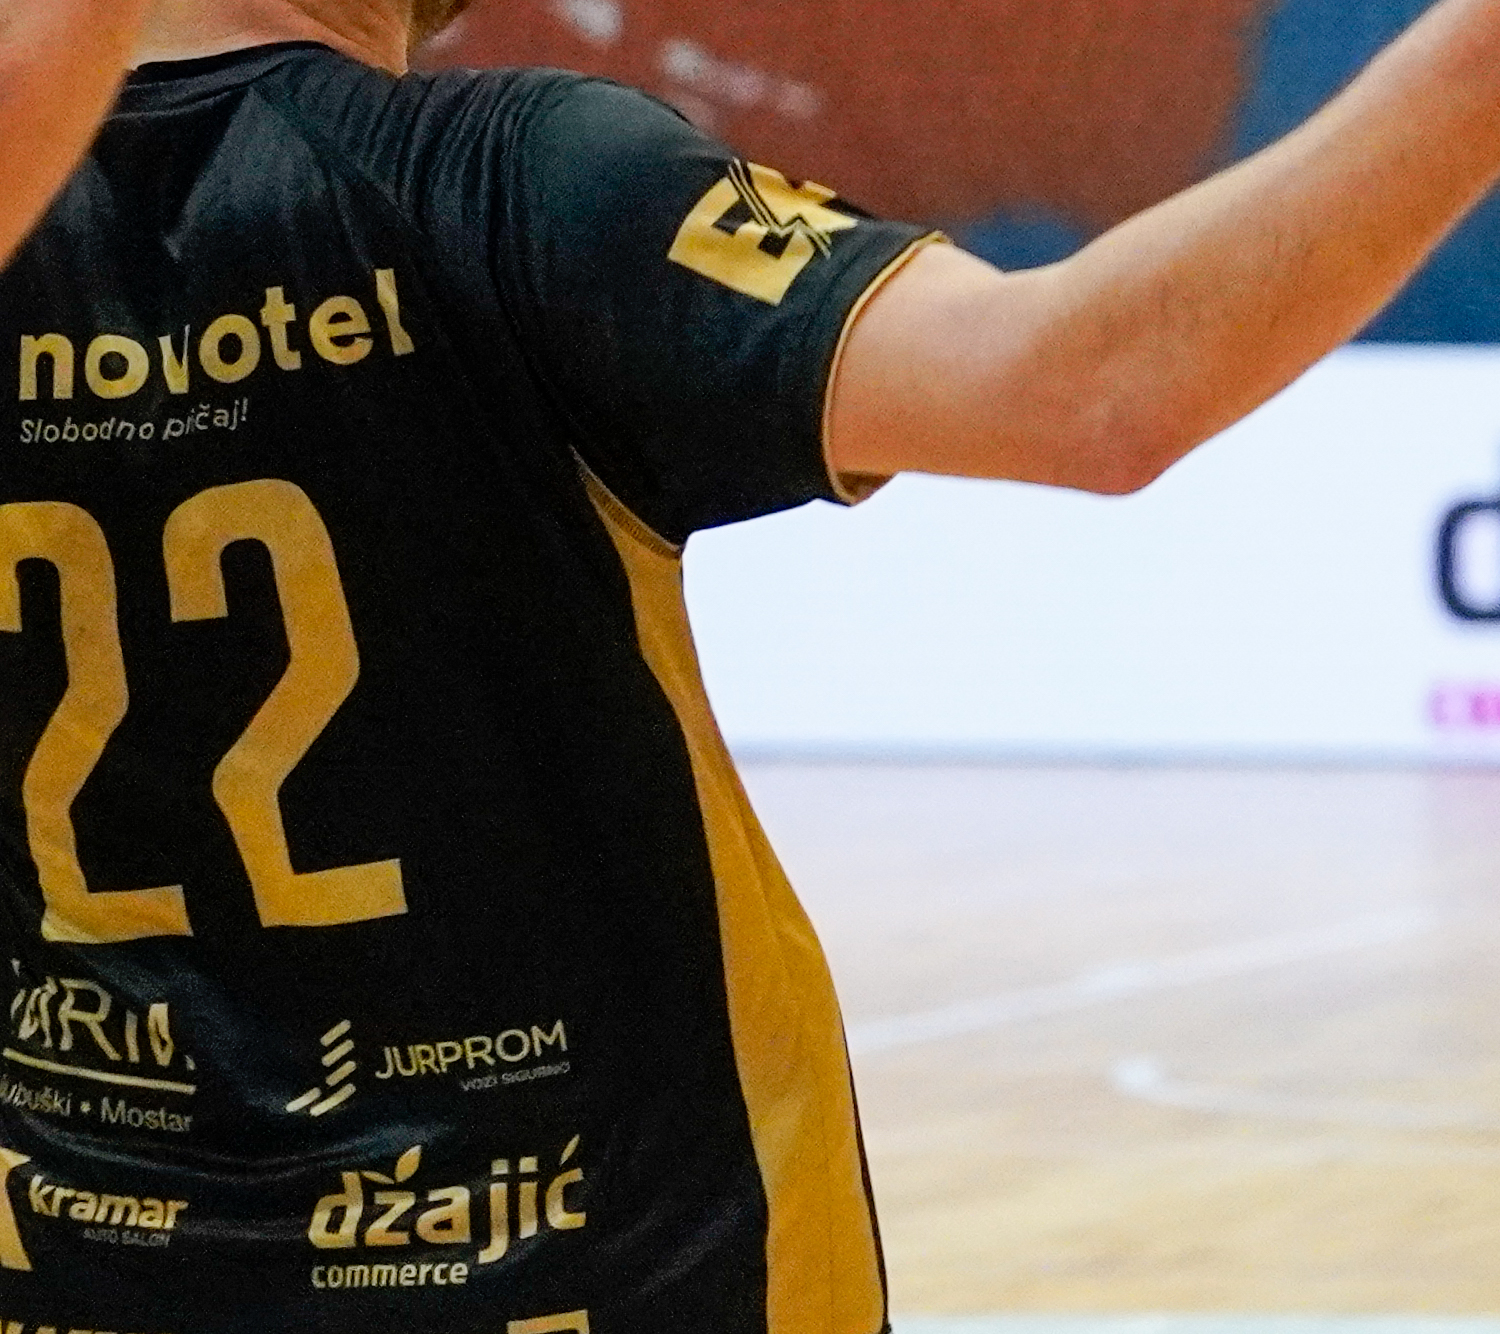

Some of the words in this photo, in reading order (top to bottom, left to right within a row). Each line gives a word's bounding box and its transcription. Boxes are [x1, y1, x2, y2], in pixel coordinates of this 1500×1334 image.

[18, 268, 415, 401] novotel
[19, 417, 155, 445] Slobodno
[0, 479, 409, 946] 22
[375, 1019, 568, 1079] JURPROM
[101, 1096, 193, 1132] Mostar
[28, 1174, 189, 1230] kramar
[308, 1133, 588, 1264] džajić
[311, 1260, 470, 1289] commerce
